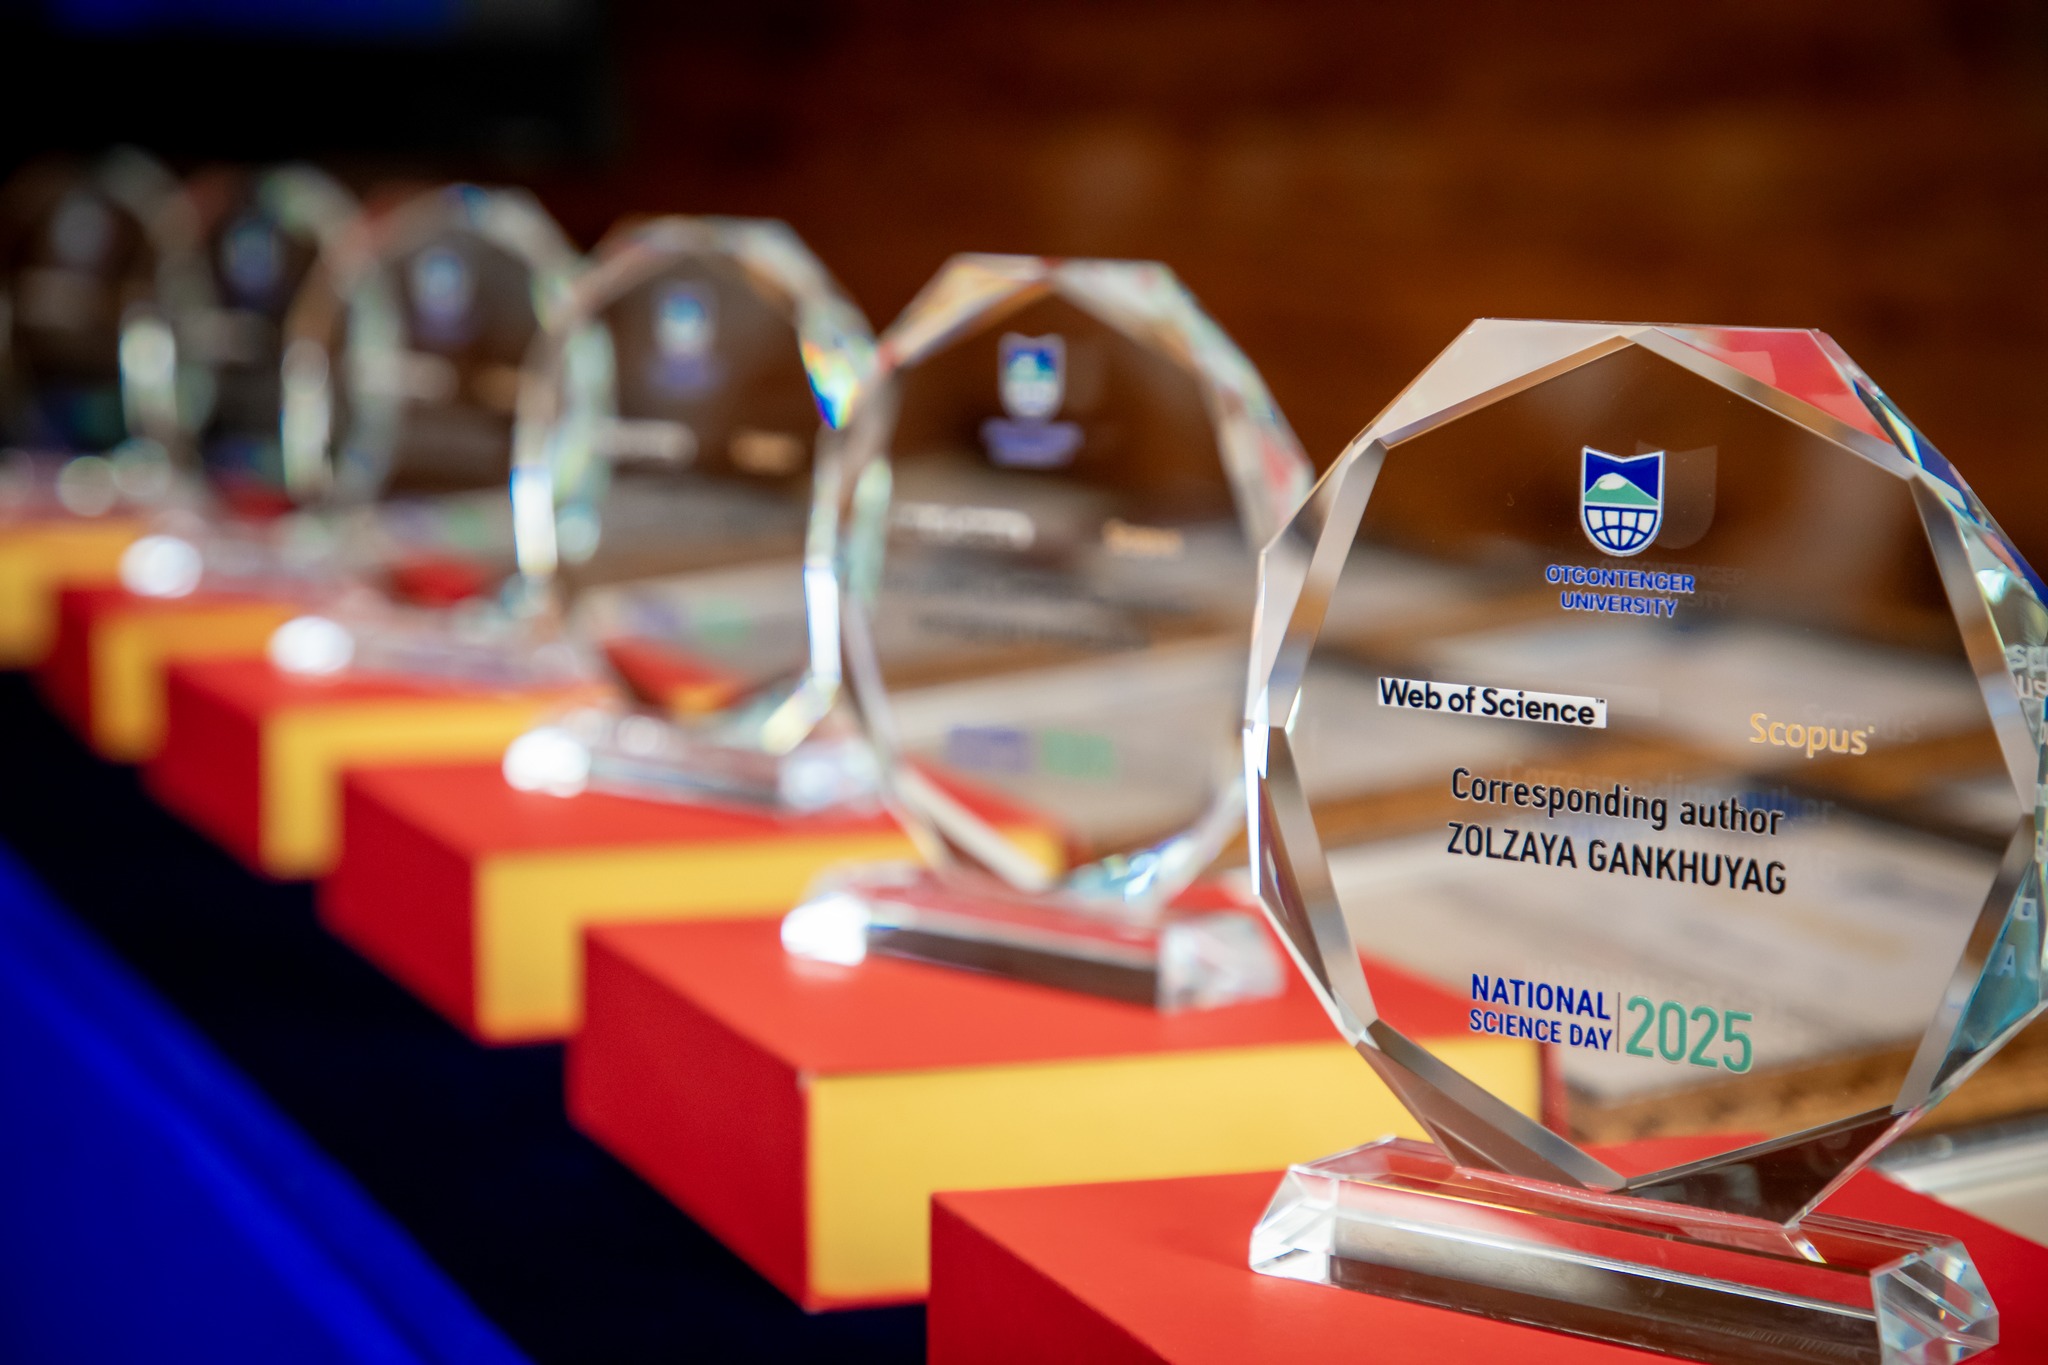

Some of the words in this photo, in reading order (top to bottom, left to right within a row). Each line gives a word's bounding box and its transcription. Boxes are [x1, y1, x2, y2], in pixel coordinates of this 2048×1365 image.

[1545, 564, 1696, 593] OTGONTENGER
[1560, 592, 1679, 618] UNIVERSITY
[1380, 678, 1442, 710] Web
[1447, 686, 1476, 713] of
[1452, 767, 1668, 830] Corresponding
[1680, 796, 1784, 835] author
[1447, 822, 1578, 868] ZOLZAYA
[1588, 840, 1787, 894] GANKHUYAG
[1471, 973, 1611, 1020] NATIONAL
[1469, 1009, 1562, 1043] SCIENCE
[1570, 1024, 1613, 1052] DAY
[1625, 996, 1755, 1075] 2025
